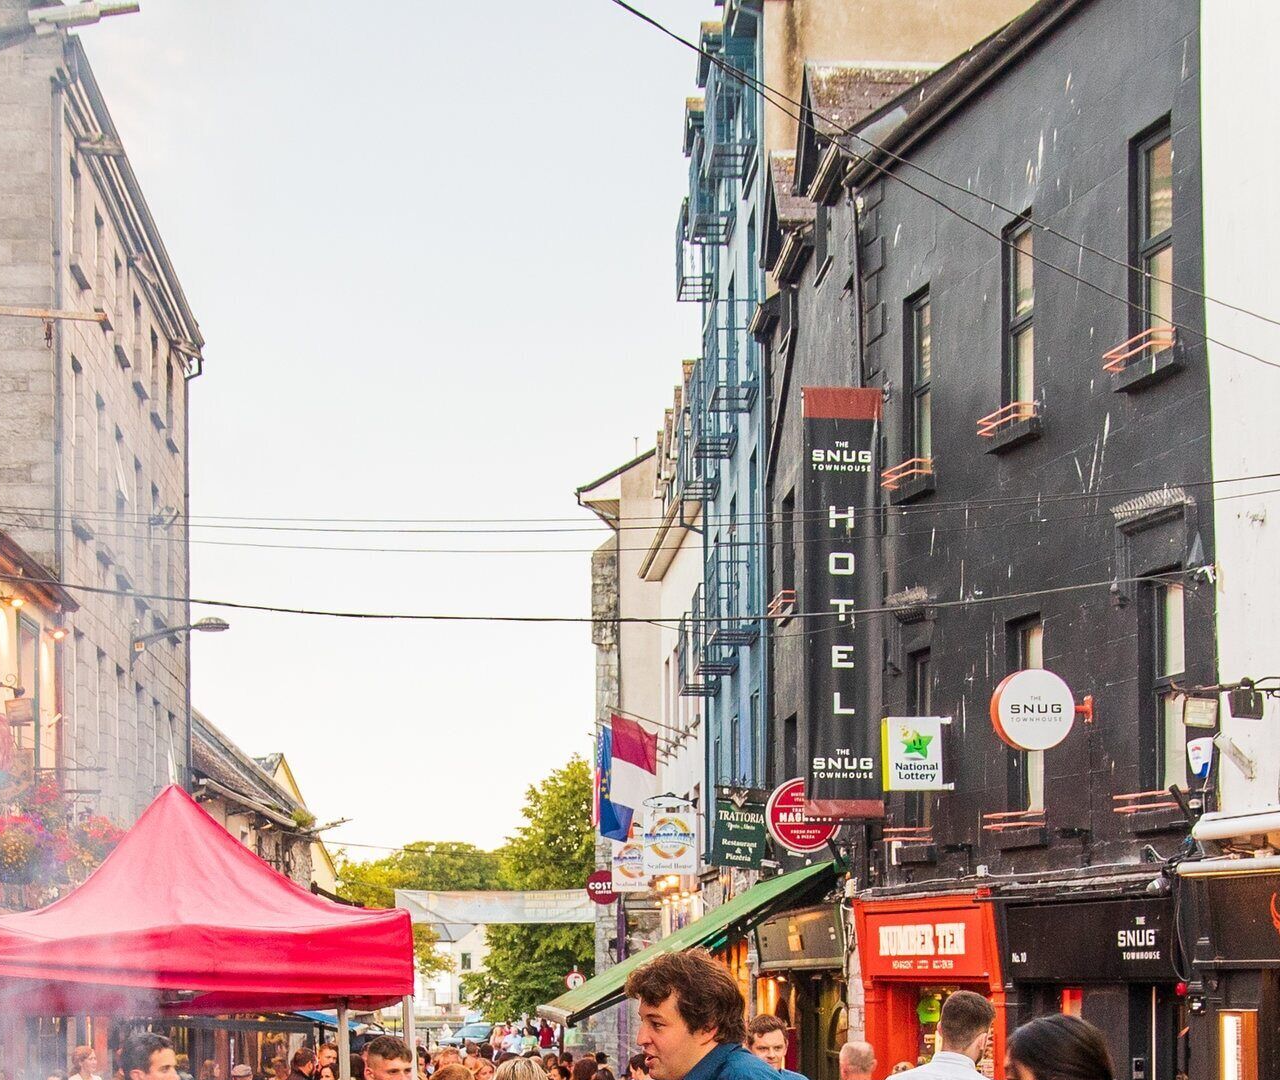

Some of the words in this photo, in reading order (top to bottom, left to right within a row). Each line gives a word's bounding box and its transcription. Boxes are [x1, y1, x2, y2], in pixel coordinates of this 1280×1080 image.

[812, 450, 871, 462] SNUG
[812, 464, 871, 472] TOWNHOUSE
[829, 506, 855, 714] HOTEL
[1010, 704, 1062, 714] SNUG
[813, 758, 873, 770] SNUG
[895, 762, 939, 771] National
[898, 772, 936, 782] Lottery
[719, 810, 765, 824] TRATTORIA
[722, 838, 757, 848] Restaurant
[1135, 916, 1145, 925] THE
[879, 924, 934, 956] NUMBER
[935, 922, 965, 955] TEN
[1117, 929, 1155, 947] SNUG
[1122, 951, 1160, 960] TOWNHOUSE
